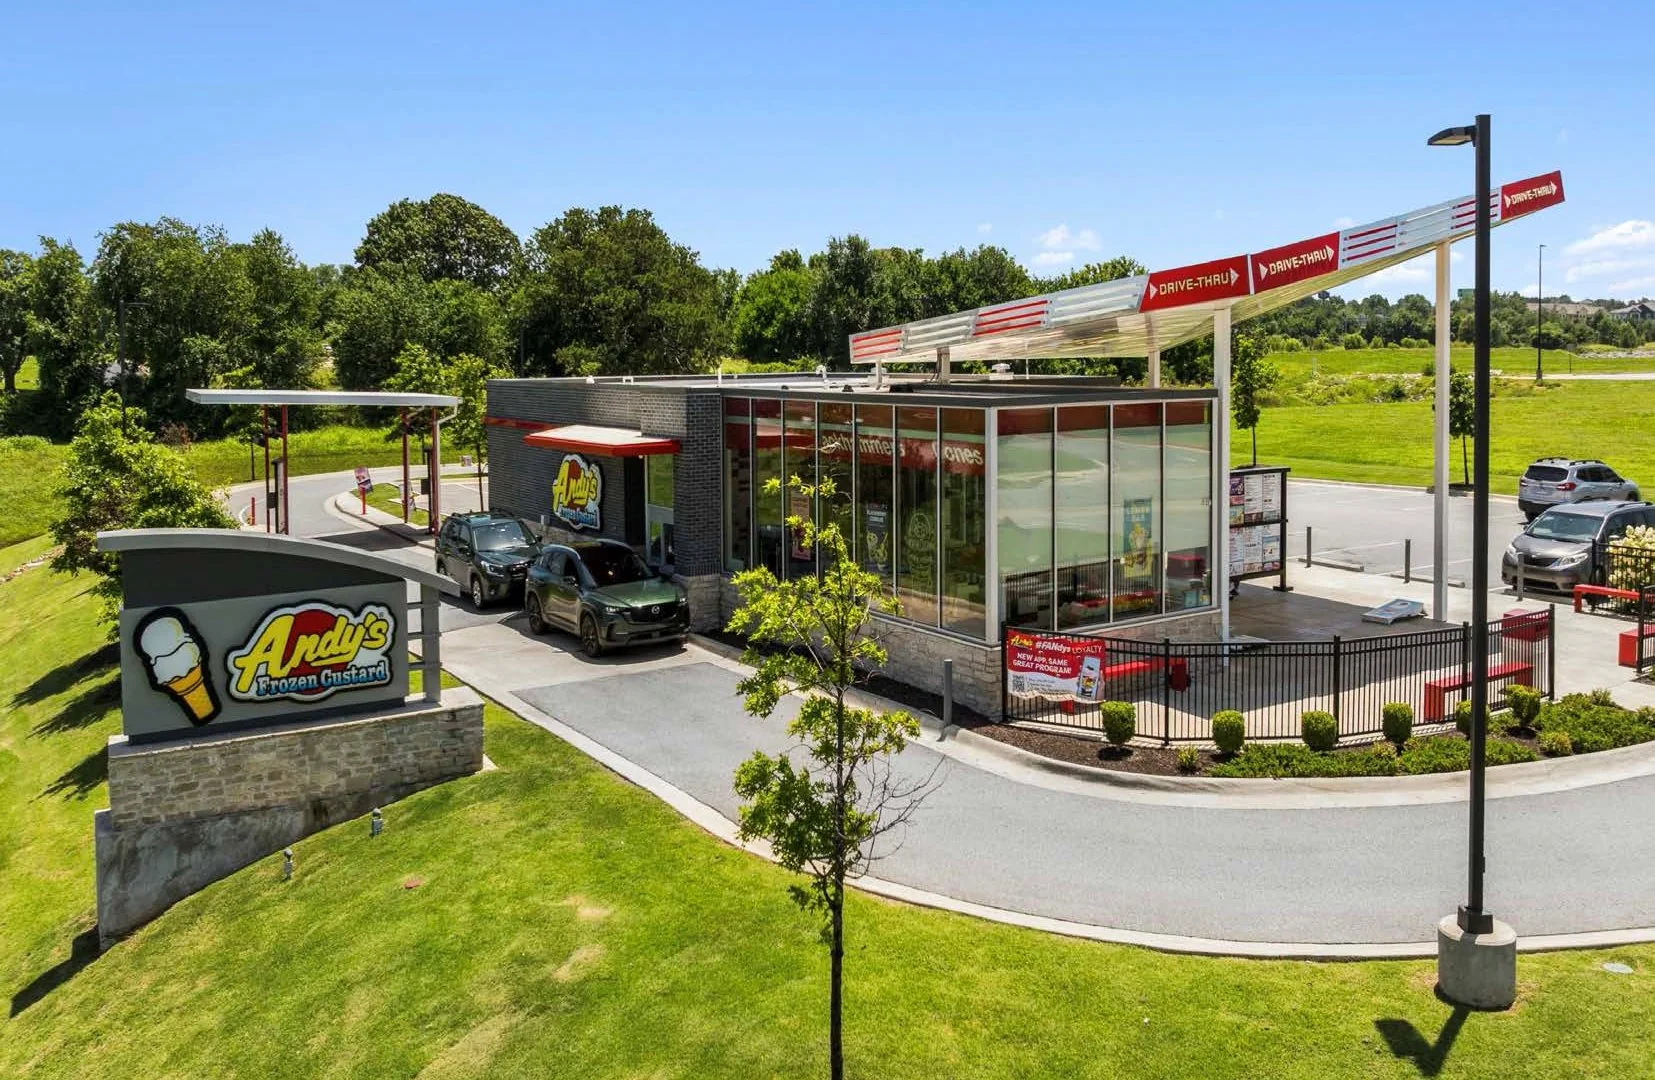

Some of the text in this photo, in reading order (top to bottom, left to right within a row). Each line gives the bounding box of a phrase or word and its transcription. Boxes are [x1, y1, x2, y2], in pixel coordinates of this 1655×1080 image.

[1510, 184, 1552, 205] DRIVE-THRU
[1268, 248, 1328, 275] DRIVE-THRU
[1159, 272, 1230, 295] DRIVE-THRU
[552, 461, 598, 512] Andy's
[234, 611, 390, 693] Andy's
[1017, 653, 1032, 661] NEW
[1049, 657, 1068, 666] SAME
[256, 661, 386, 696] Frozen Custard
[1013, 660, 1071, 673] GREAT PROGRAM!
